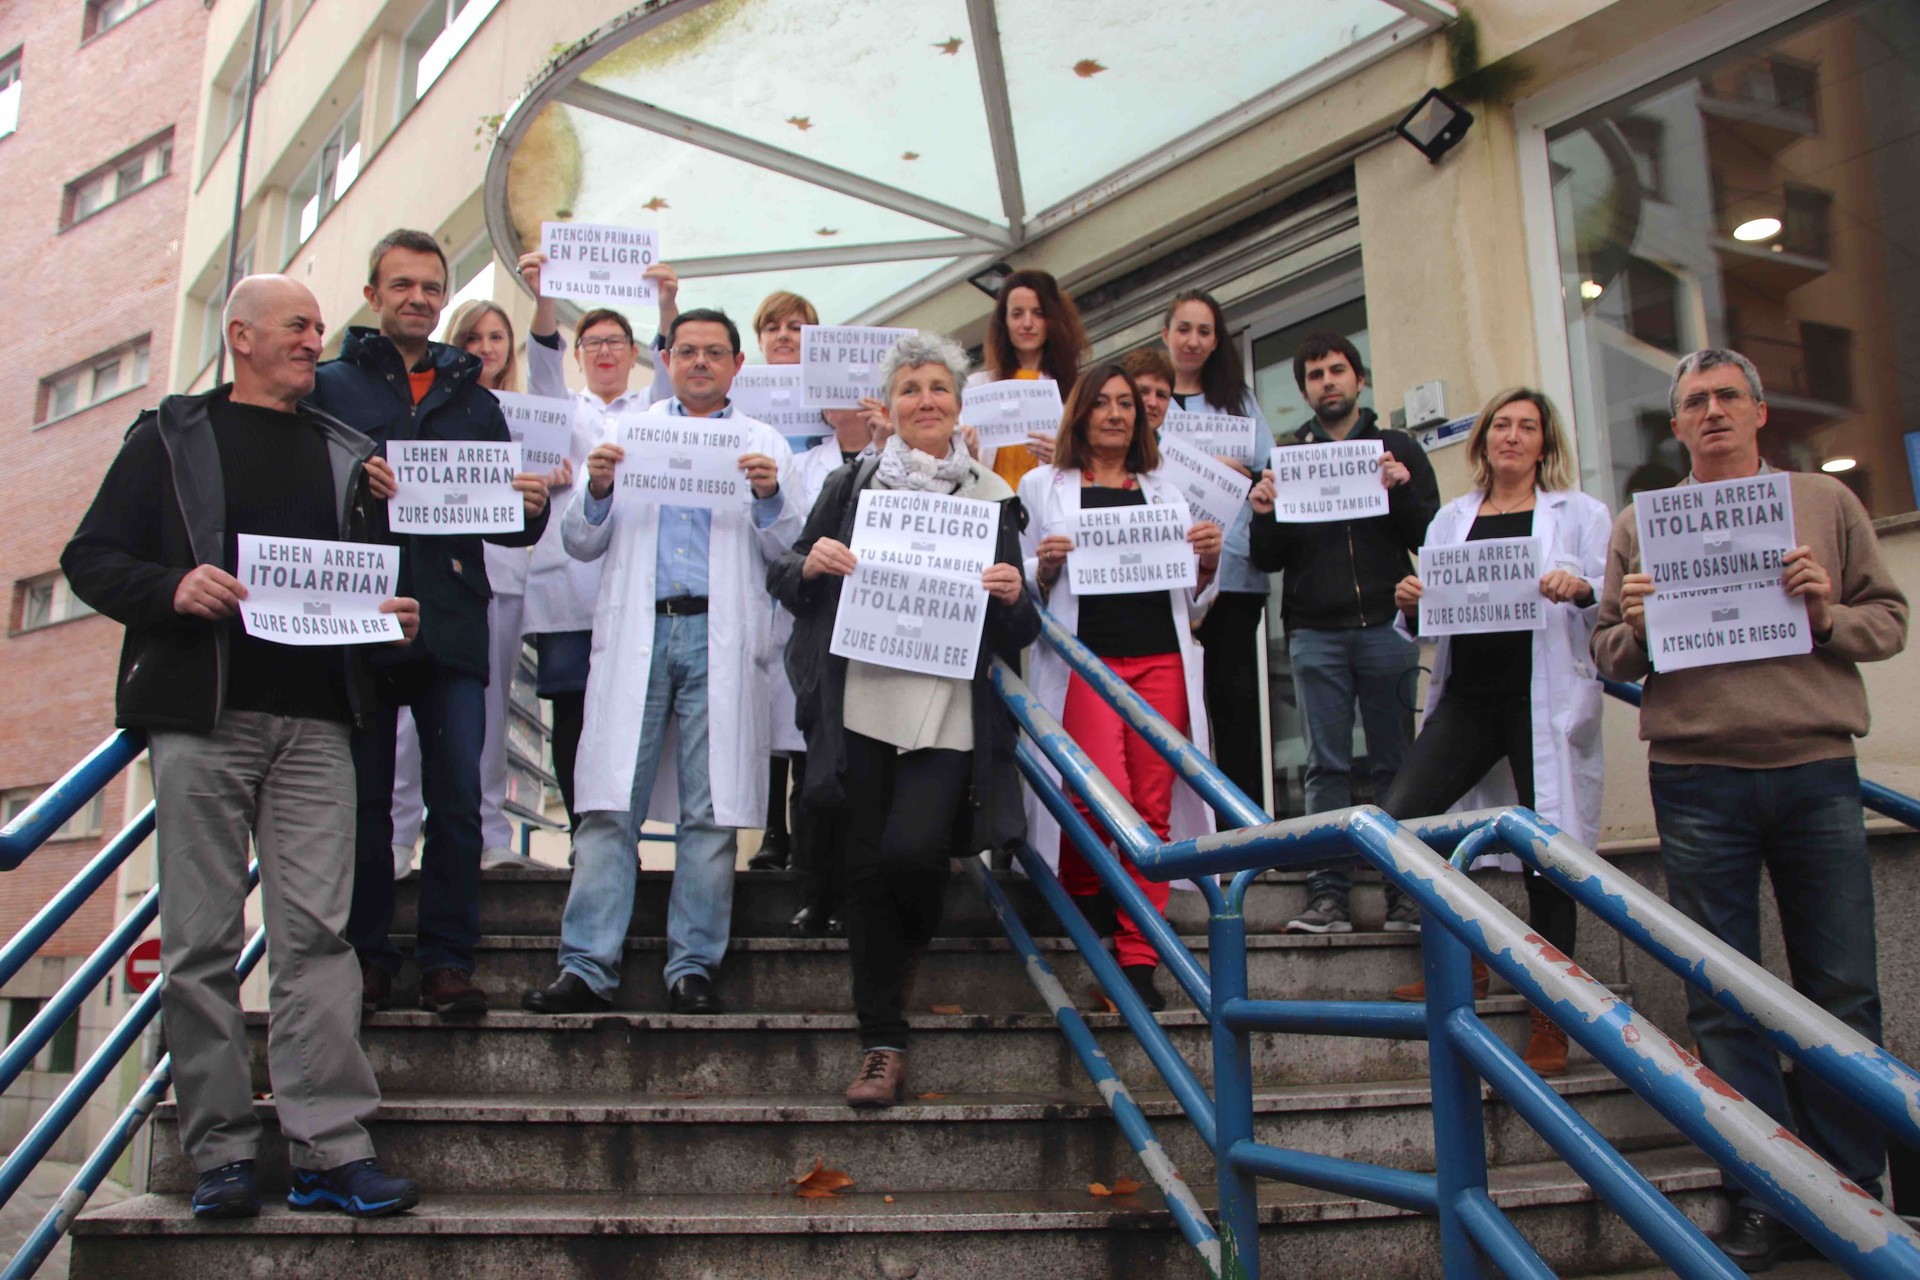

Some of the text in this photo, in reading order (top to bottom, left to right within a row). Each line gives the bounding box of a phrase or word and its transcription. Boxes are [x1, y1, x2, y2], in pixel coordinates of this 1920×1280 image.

[551, 227, 651, 246] ATENCIÓN PRIMARIA
[550, 244, 651, 264] EN PELIGRO
[549, 280, 562, 290] TU
[567, 282, 600, 294] SALUD
[810, 347, 886, 363] EN PELIG
[779, 377, 791, 387] SIN
[809, 386, 822, 398] TU
[827, 387, 859, 399] SALUD
[1008, 390, 1020, 399] SIN
[1024, 389, 1053, 398] TIEMPO
[516, 407, 531, 420] SIN
[534, 410, 566, 425] TIEMPO
[782, 413, 792, 424] DE
[1014, 422, 1023, 432] DE
[1028, 419, 1058, 431] RIESGO
[627, 427, 740, 448] ATENCIÓN SIN TIEMPO
[1162, 422, 1249, 432] ITOLARRIAN
[404, 448, 448, 462] LEHEN
[458, 448, 509, 463] ARRETA
[527, 450, 560, 465] RIESGO
[1231, 445, 1247, 458] ERE
[1280, 445, 1377, 463] ATENCIÓN PRIMARIA
[398, 466, 514, 483] ITOLARRIAN
[1281, 460, 1379, 481] EN PELIGRO
[623, 473, 735, 495] ATENCIÓN DE RIESGO
[1204, 468, 1215, 482] SIN
[1219, 475, 1243, 499] TIEMPO
[869, 494, 990, 519] ATENCIÓN PRIMARIA
[1283, 494, 1381, 514] TU SALUD TAMBIÉN
[1653, 482, 1776, 513] LEHEN ARRETA
[398, 507, 515, 524] ZURE OSASUNA ERE
[866, 511, 988, 539] EN PELIGRO
[1080, 509, 1178, 527] LEHEN ARRETA
[1649, 502, 1784, 538] ITOLARRIAN
[1076, 525, 1184, 547] ITOLARRIAN
[258, 543, 385, 570] LEHEN ARRETA
[860, 549, 984, 574] TU SALUD TAMBIÉN
[1432, 544, 1529, 566] LEHEN ARRETA
[1078, 562, 1187, 585] ZURE OSASUNA ERE
[1427, 563, 1535, 586] ITOLARRIAN
[1654, 561, 1688, 583] ZURE
[1693, 553, 1759, 577] OSASUNA
[250, 564, 388, 595] ITOLARRIAN
[862, 569, 975, 600] LEHEN ARRETA
[851, 587, 977, 623] ITOLARRIAN
[1427, 602, 1536, 625] ZURE OSASUNA ERE
[251, 612, 390, 636] ZURE OSASUNA ERE
[842, 628, 968, 667] ZURE OSASUNA ERE
[1662, 622, 1797, 653] ATENCIÓN DE RIESGO
